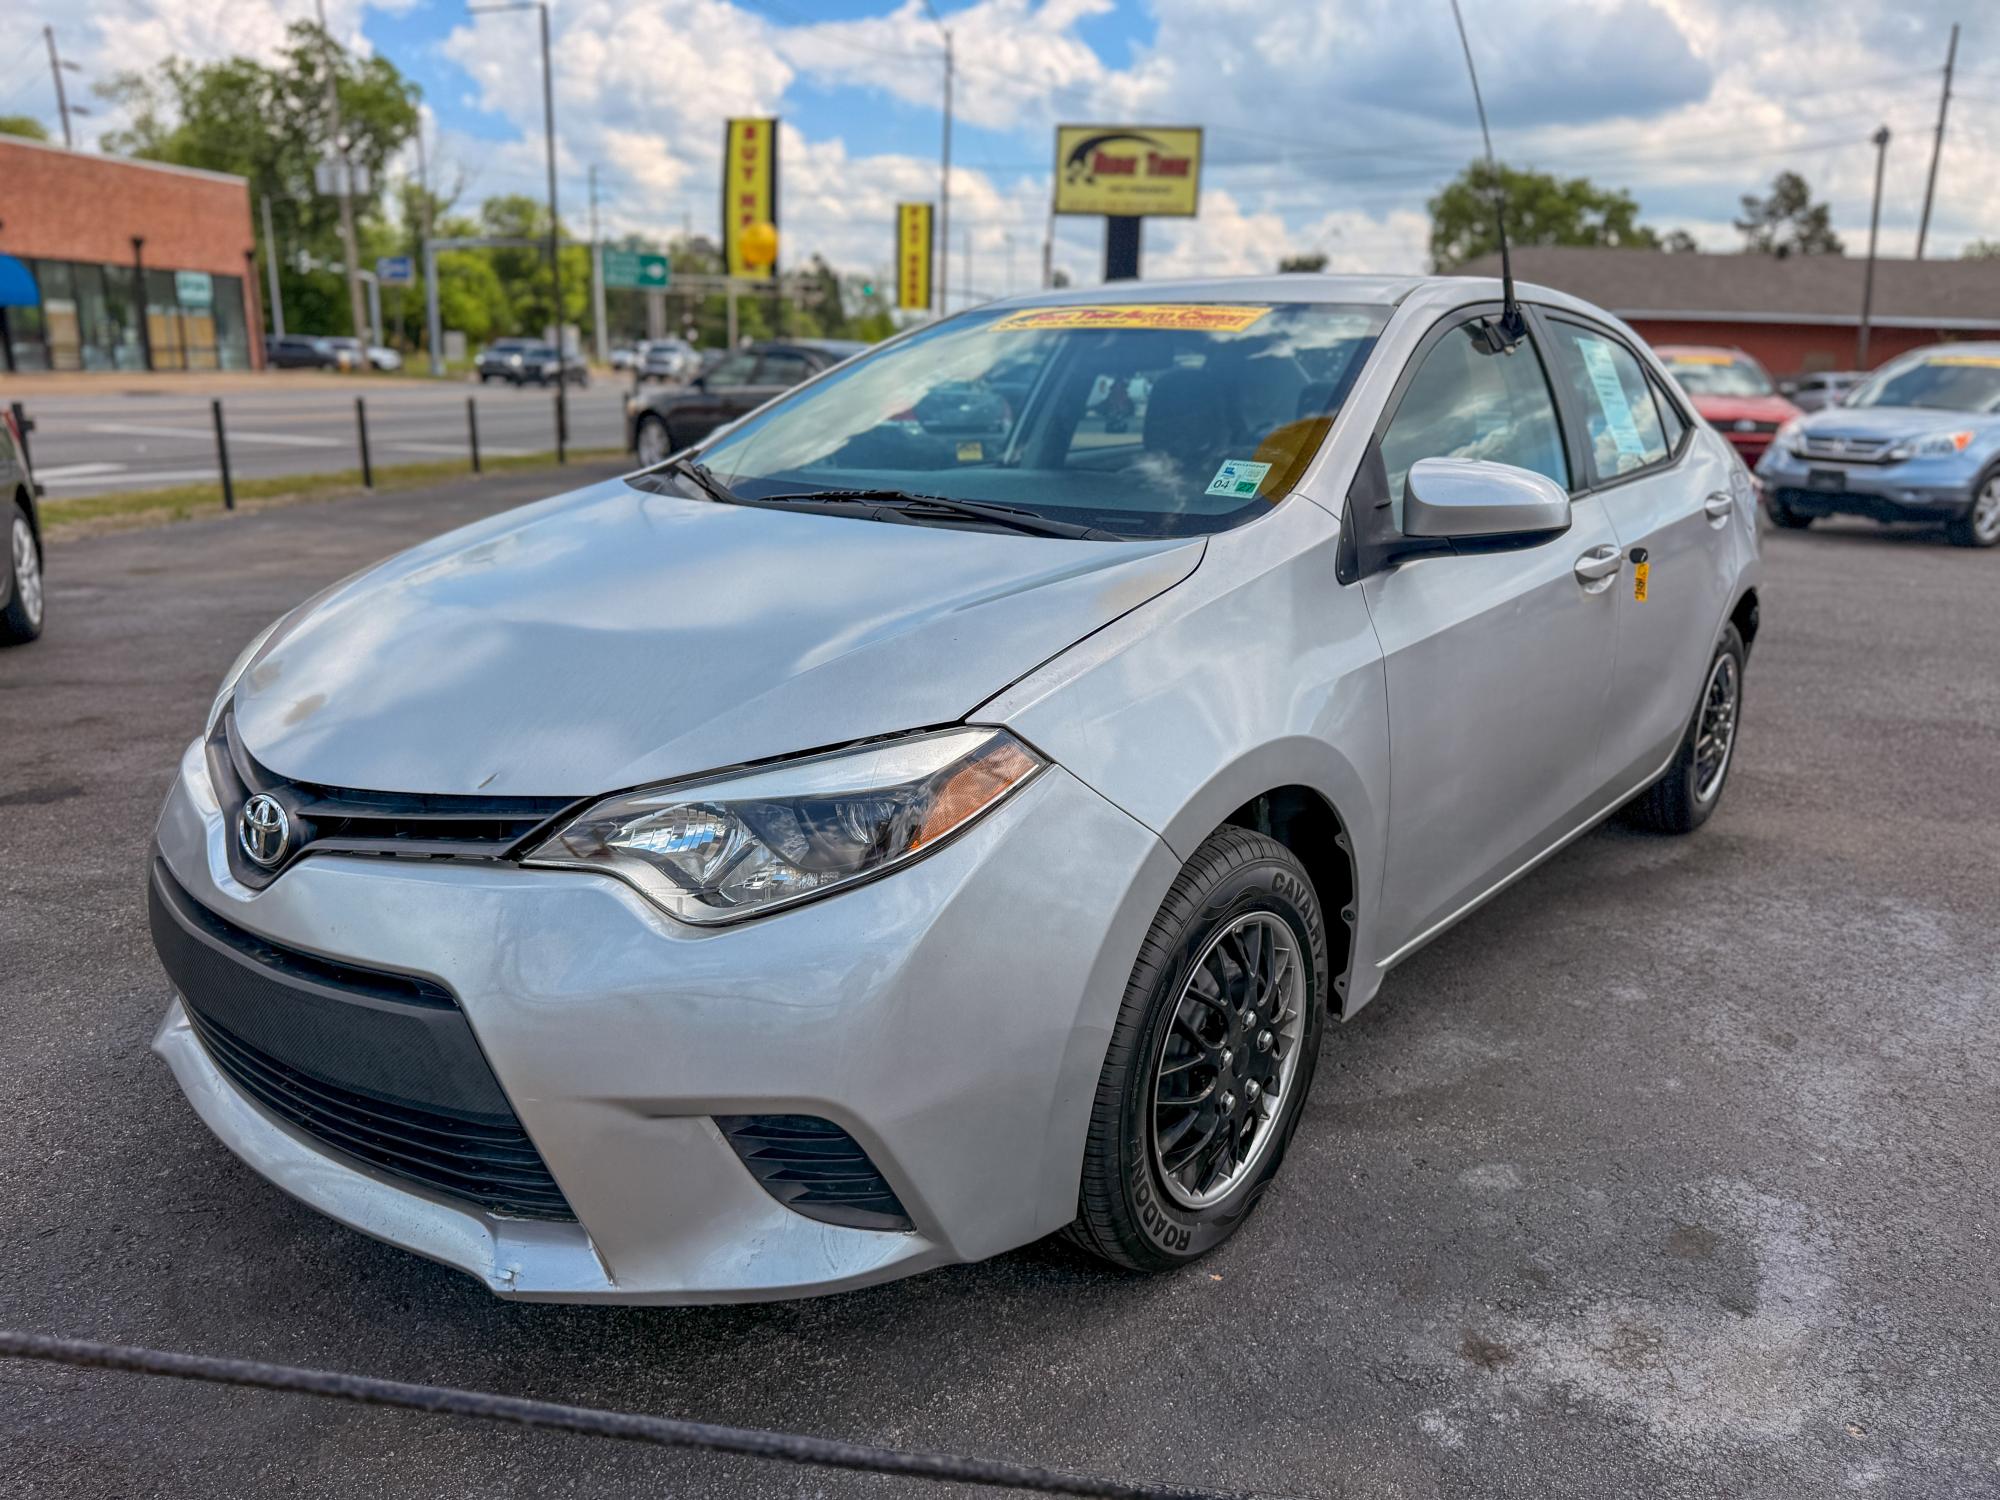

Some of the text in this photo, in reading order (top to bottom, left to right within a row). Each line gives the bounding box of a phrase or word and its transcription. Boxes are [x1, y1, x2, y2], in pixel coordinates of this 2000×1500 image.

[1213, 480, 1230, 489] 04
[1272, 872, 1322, 960] CAVALRY
[1130, 1135, 1192, 1251] ROADONE
